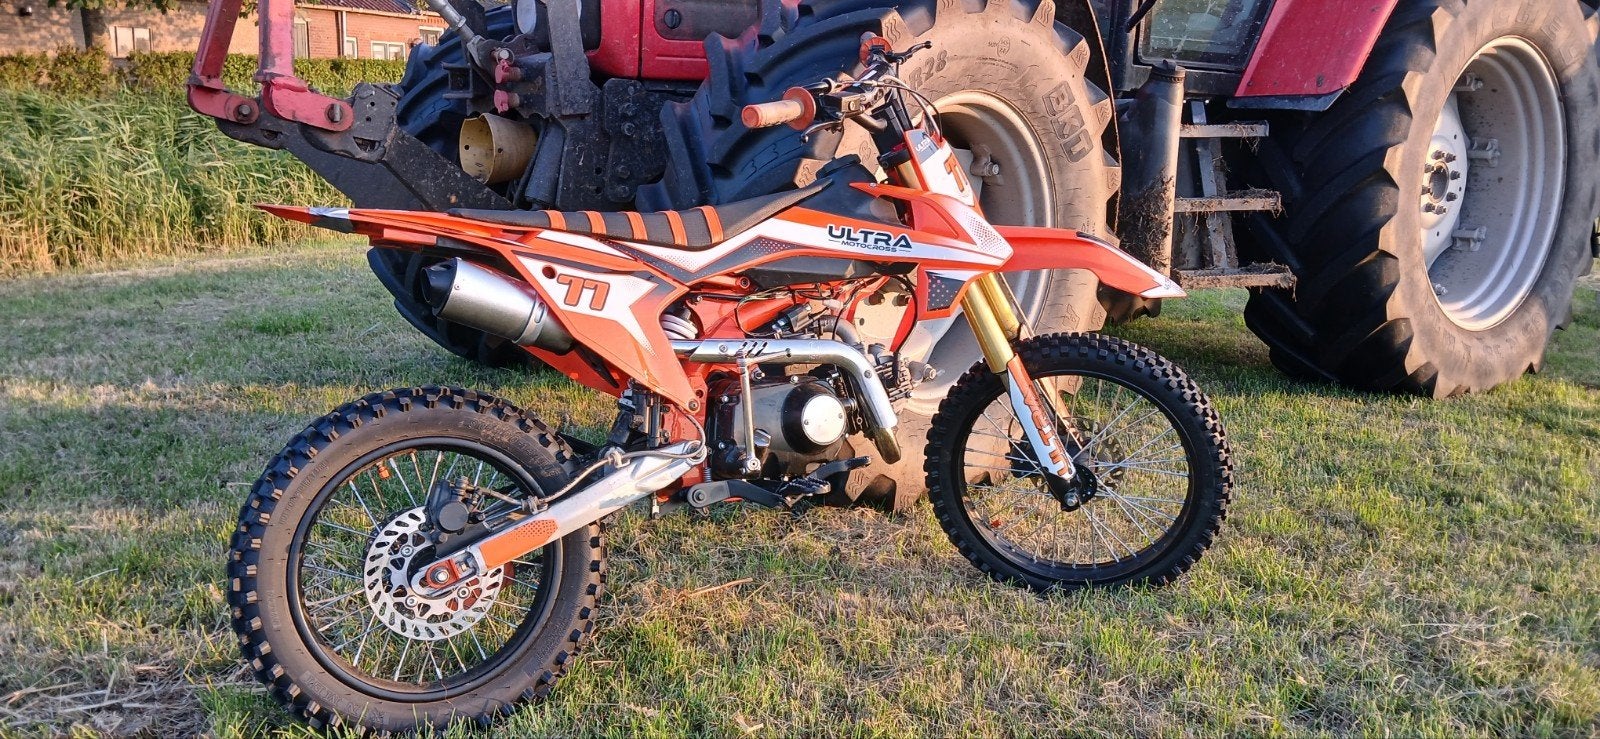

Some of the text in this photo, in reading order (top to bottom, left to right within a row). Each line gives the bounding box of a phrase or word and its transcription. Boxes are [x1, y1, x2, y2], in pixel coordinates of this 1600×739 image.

[1042, 80, 1094, 164] BKT
[828, 225, 913, 250] ULTRA
[840, 240, 898, 253] MOTOCROSS
[556, 272, 611, 312] 77
